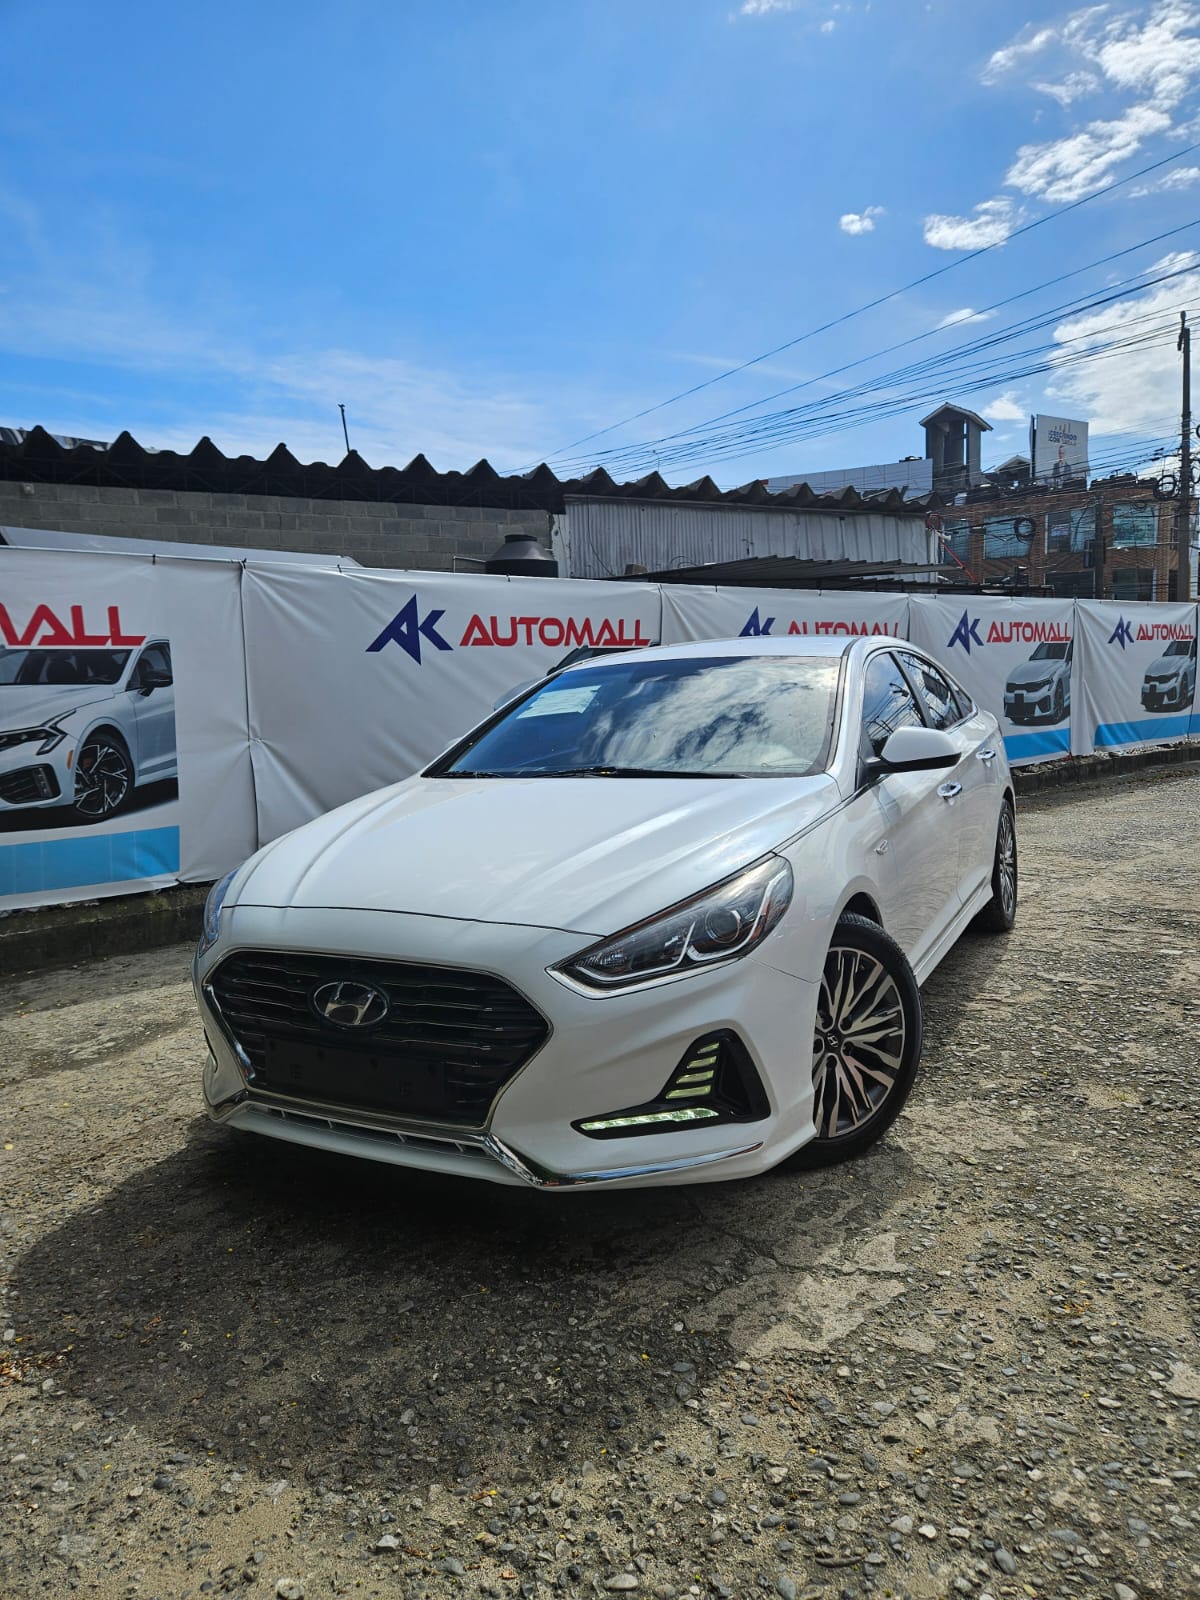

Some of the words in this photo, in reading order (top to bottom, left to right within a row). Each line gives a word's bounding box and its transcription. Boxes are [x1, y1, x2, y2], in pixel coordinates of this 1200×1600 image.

[365, 593, 454, 666] AK
[459, 614, 651, 647] AUTOMALL
[947, 608, 984, 656] AK
[986, 621, 1071, 643] AUTOMALL
[1108, 614, 1135, 650] AK
[1136, 623, 1194, 641] AUTOMALL
